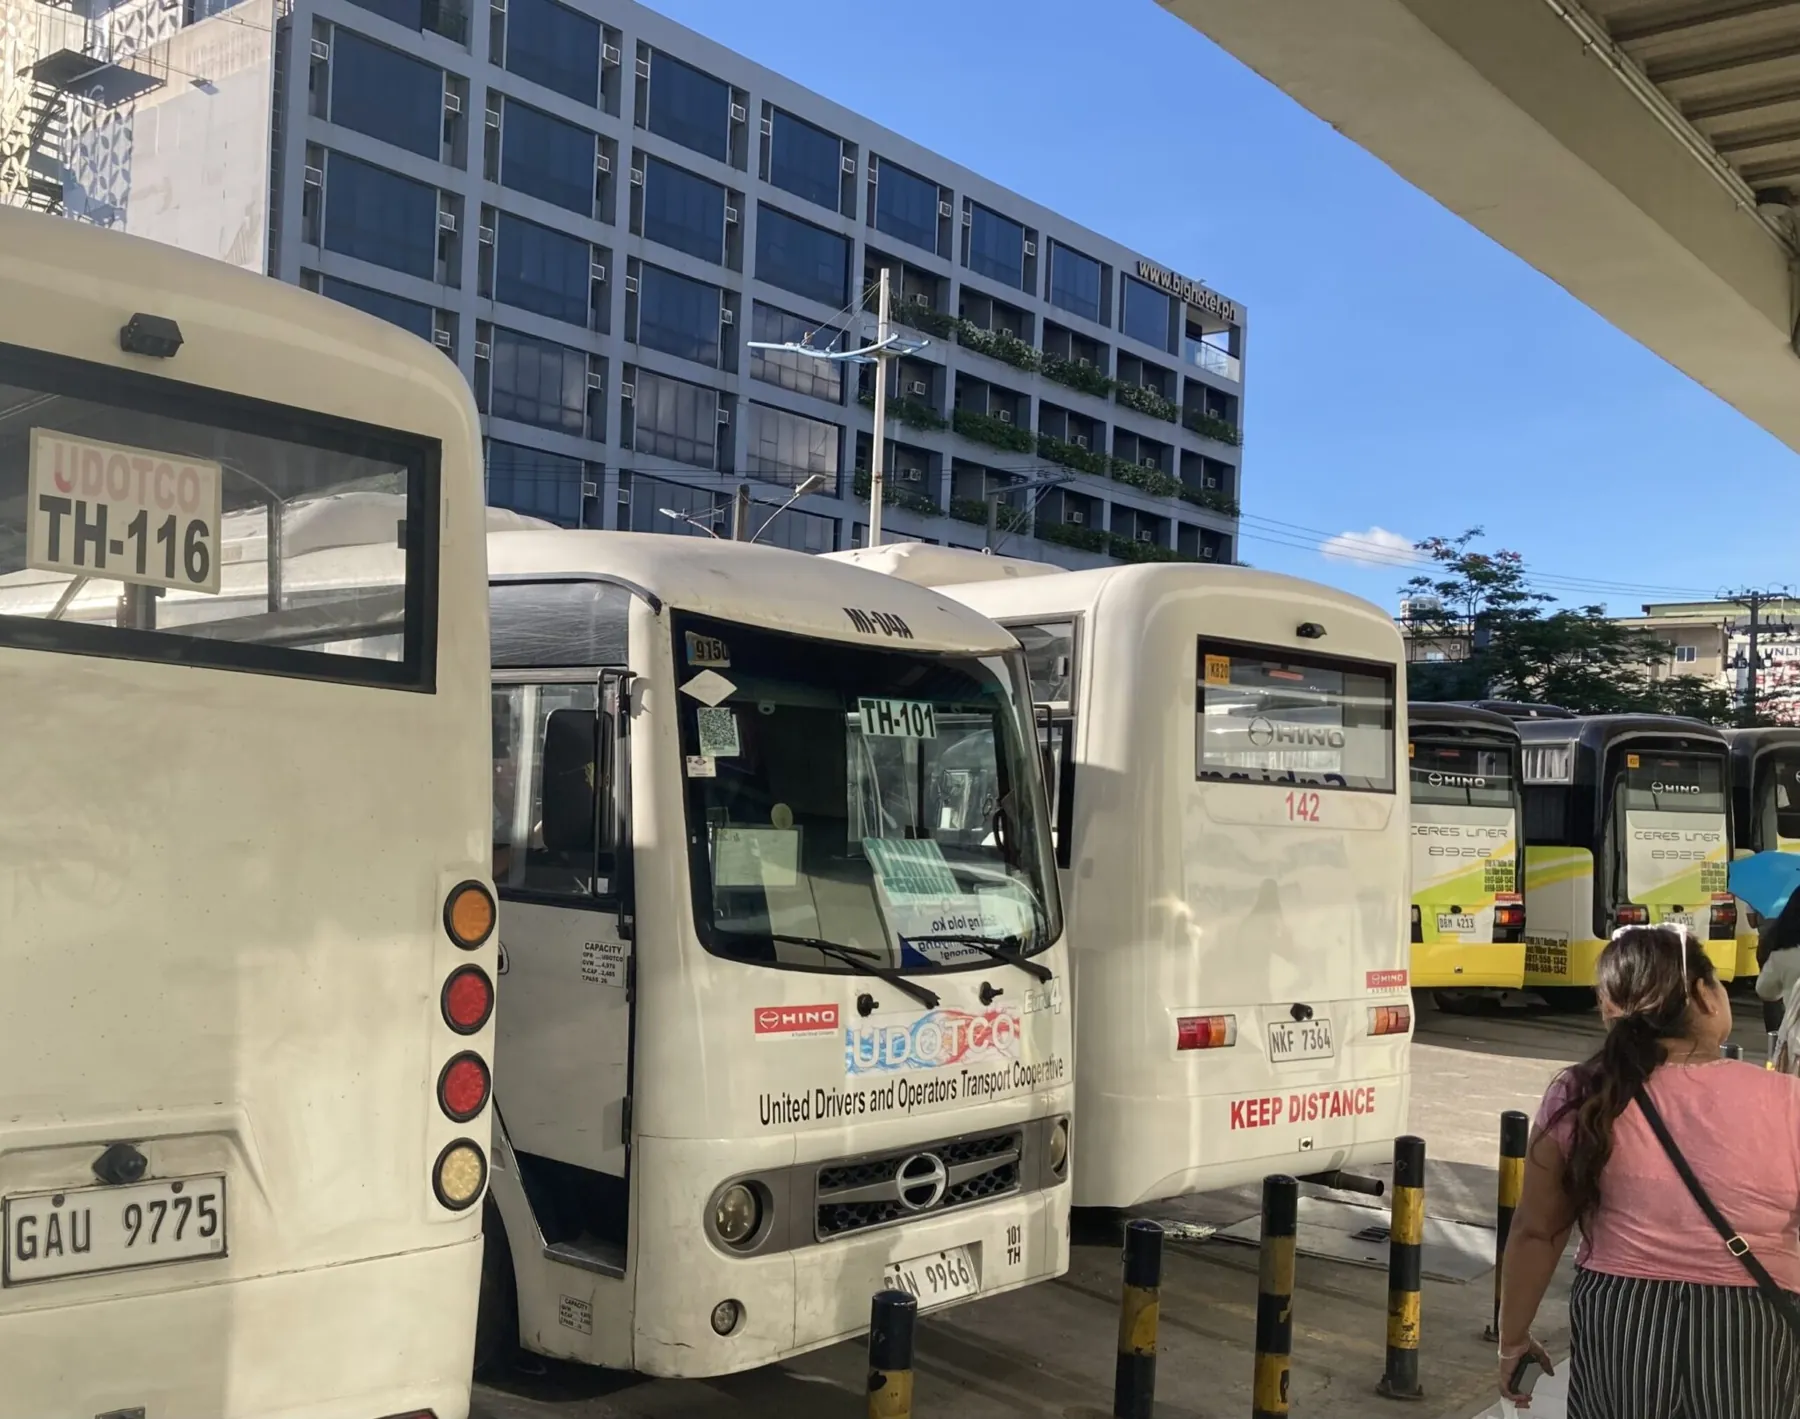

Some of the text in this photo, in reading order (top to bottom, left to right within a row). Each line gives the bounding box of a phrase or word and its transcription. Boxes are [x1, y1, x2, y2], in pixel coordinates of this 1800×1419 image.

[54, 443, 200, 513] UDOTCO
[40, 494, 211, 584] TH-116
[842, 607, 914, 640] MI-04A
[861, 700, 936, 738] TH-101
[1277, 724, 1346, 748] HINO
[1444, 776, 1486, 788] HINO
[1664, 784, 1700, 794] HINO
[1285, 791, 1320, 822] 142
[1410, 826, 1461, 837] CERES
[1634, 831, 1681, 840] CERES
[1428, 846, 1492, 858] 8926
[1651, 849, 1706, 861] 8925
[584, 942, 622, 954] CAPACITY
[1380, 974, 1403, 983] HINO
[782, 1010, 835, 1025] HINO
[853, 1014, 1016, 1068] UDOTCO
[1271, 1028, 1331, 1053] NKF 7364
[759, 1053, 1064, 1125] United Drivers and Operators Transport Cooperative
[1230, 1086, 1376, 1130] KEEP DISTANCE
[16, 1194, 218, 1261] GAU 9775
[1006, 1224, 1021, 1246] 101
[1006, 1246, 1021, 1266] TH
[925, 1257, 970, 1293] 9966
